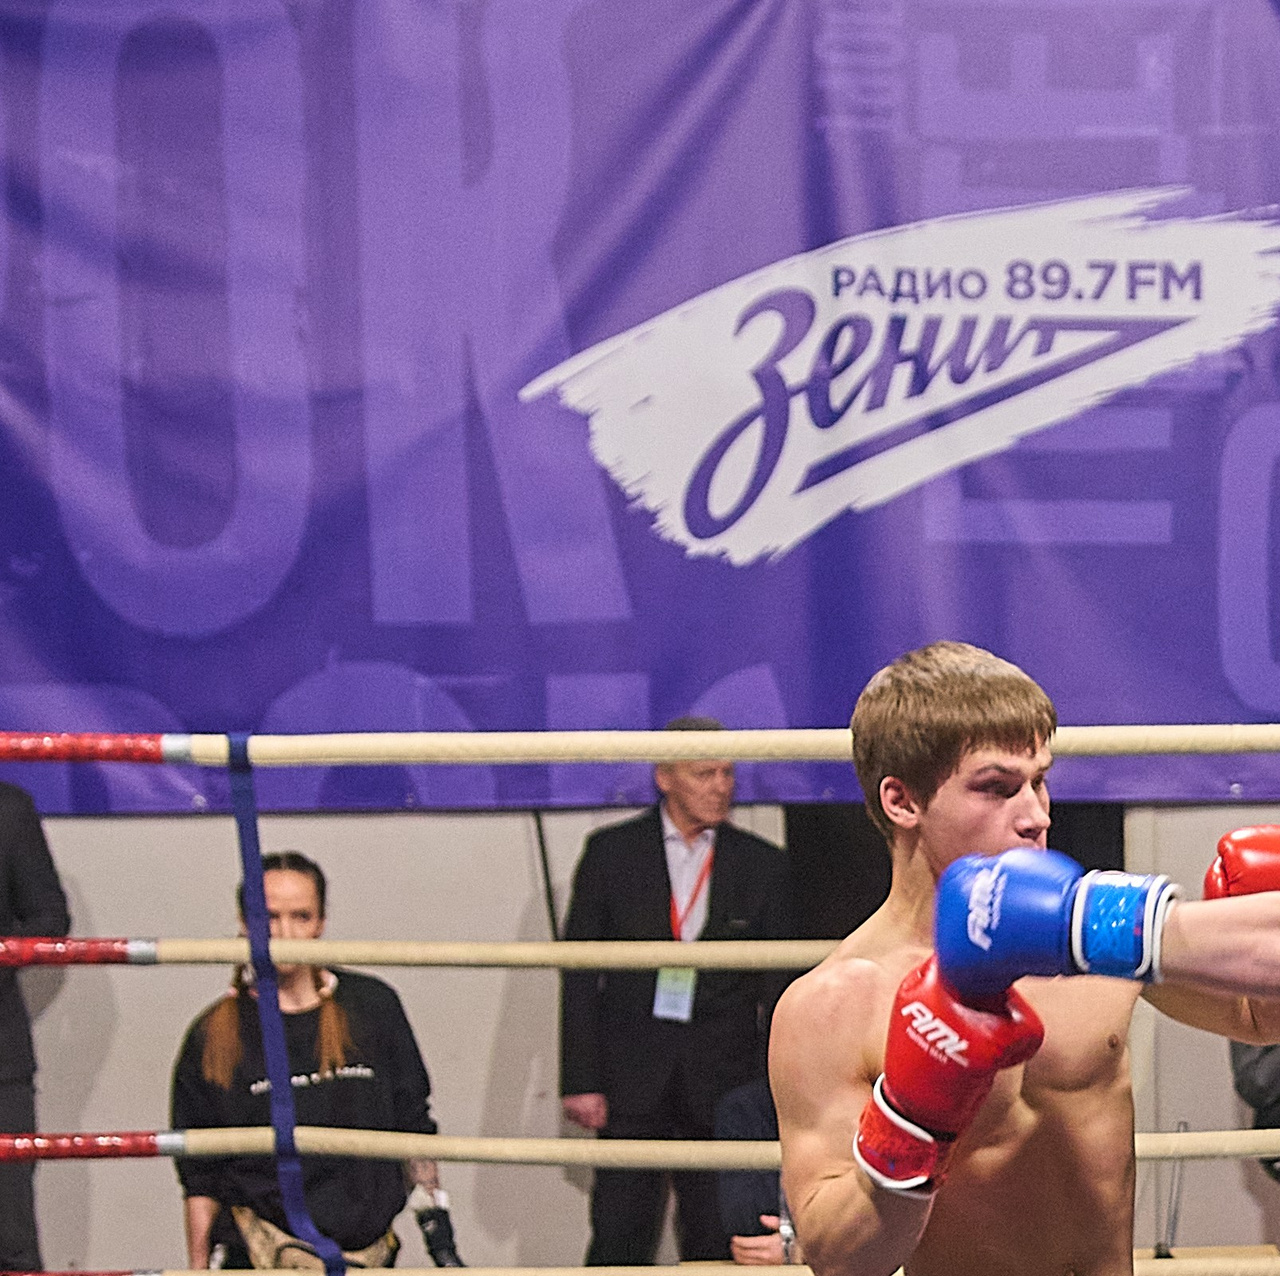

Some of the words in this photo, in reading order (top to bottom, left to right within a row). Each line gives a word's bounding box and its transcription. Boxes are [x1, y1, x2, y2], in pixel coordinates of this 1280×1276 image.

[831, 265, 989, 305] РАДИО
[1004, 258, 1118, 302] 89.7
[1126, 260, 1204, 300] FM
